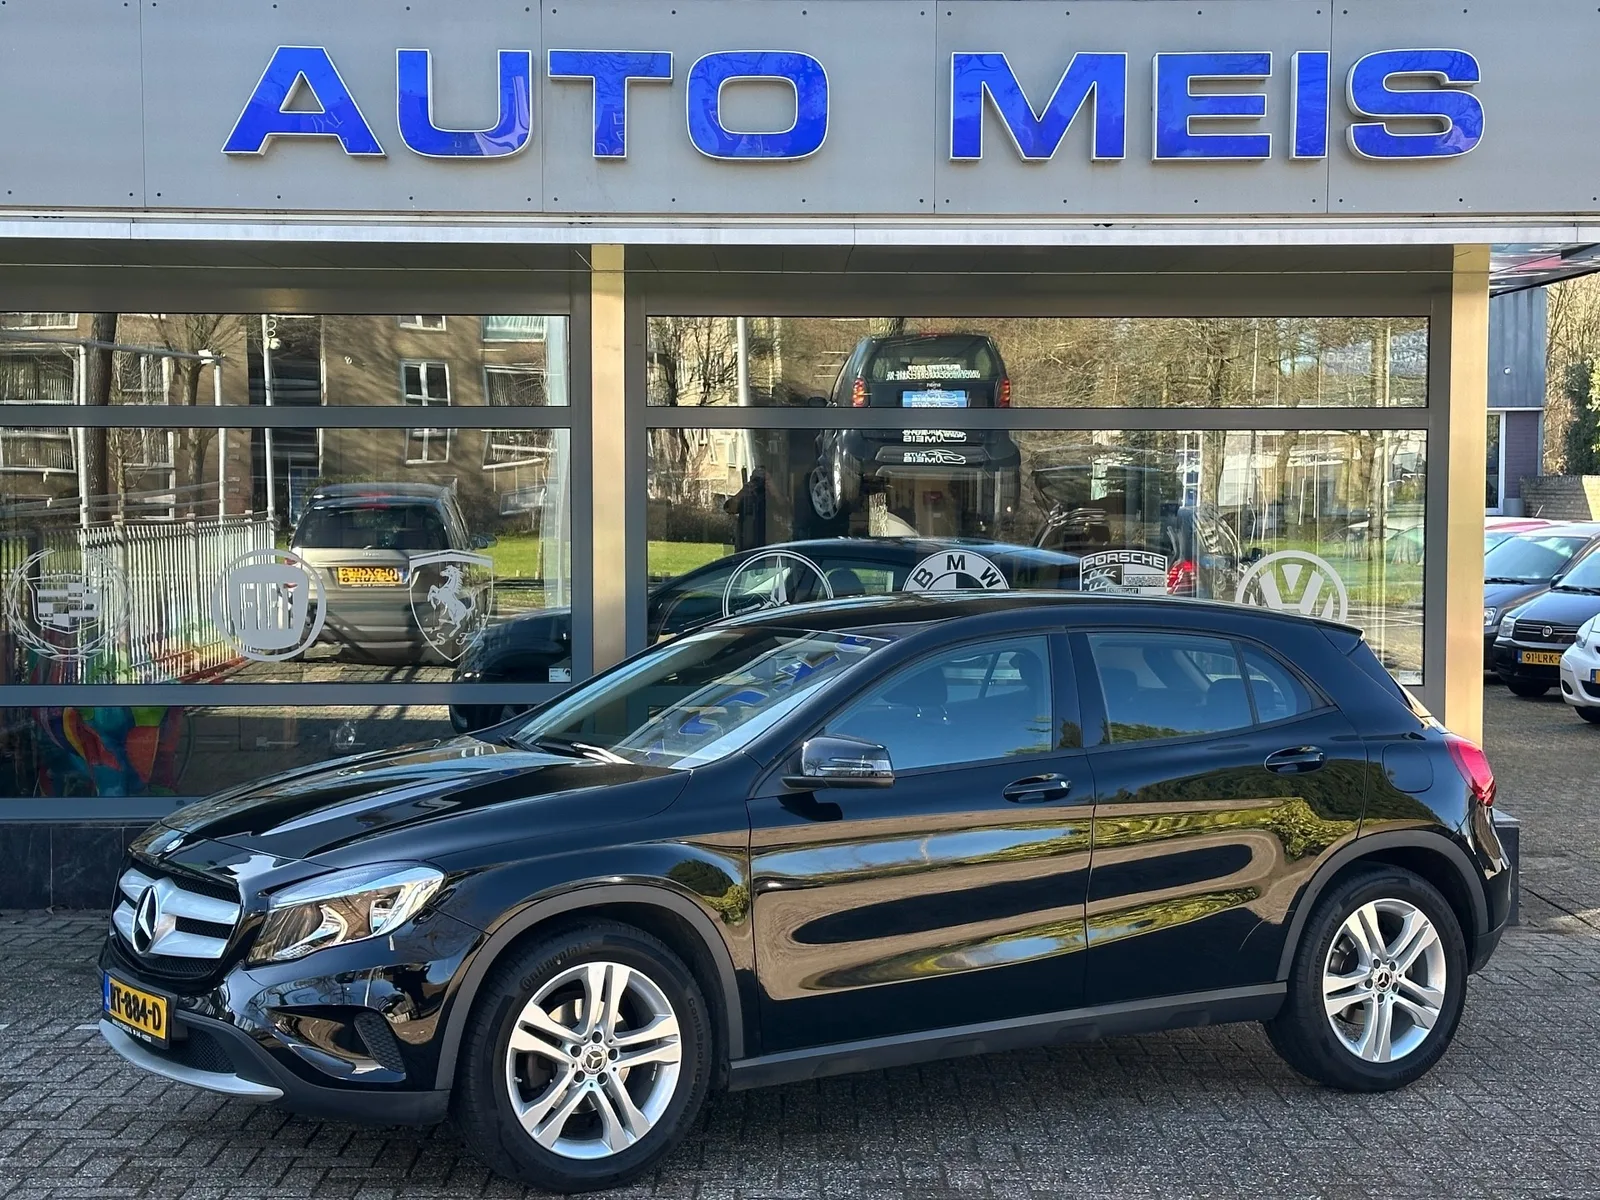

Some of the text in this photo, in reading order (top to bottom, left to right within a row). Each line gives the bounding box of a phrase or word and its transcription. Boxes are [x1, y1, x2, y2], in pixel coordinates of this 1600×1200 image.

[220, 45, 1486, 162] AUTO MEIS
[912, 554, 1001, 589] BMW
[1082, 552, 1166, 570] PORSCHE
[239, 582, 299, 630] FIAT
